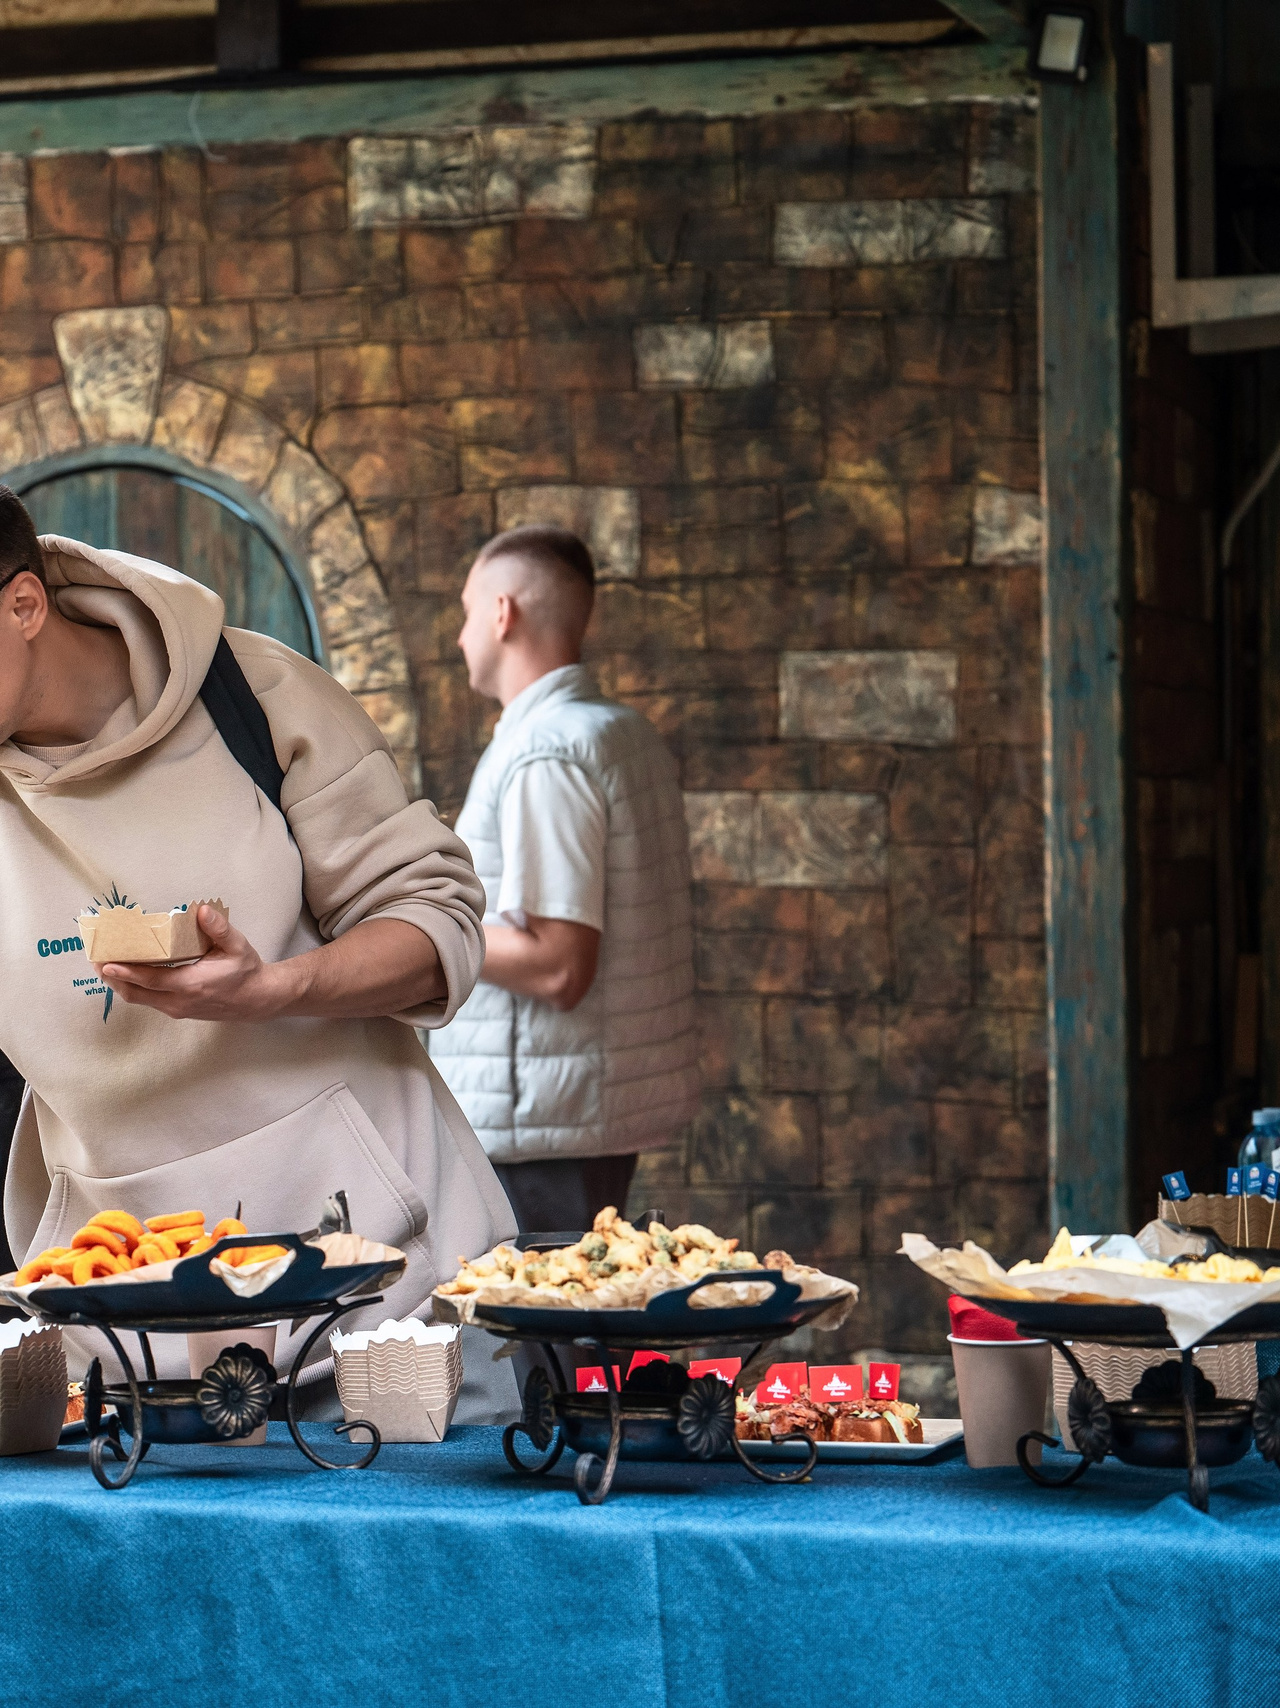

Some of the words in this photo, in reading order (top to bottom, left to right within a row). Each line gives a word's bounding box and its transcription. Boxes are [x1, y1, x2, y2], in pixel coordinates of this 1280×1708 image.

[37, 936, 85, 958] Com
[72, 977, 99, 988] Never
[84, 985, 107, 996] what
